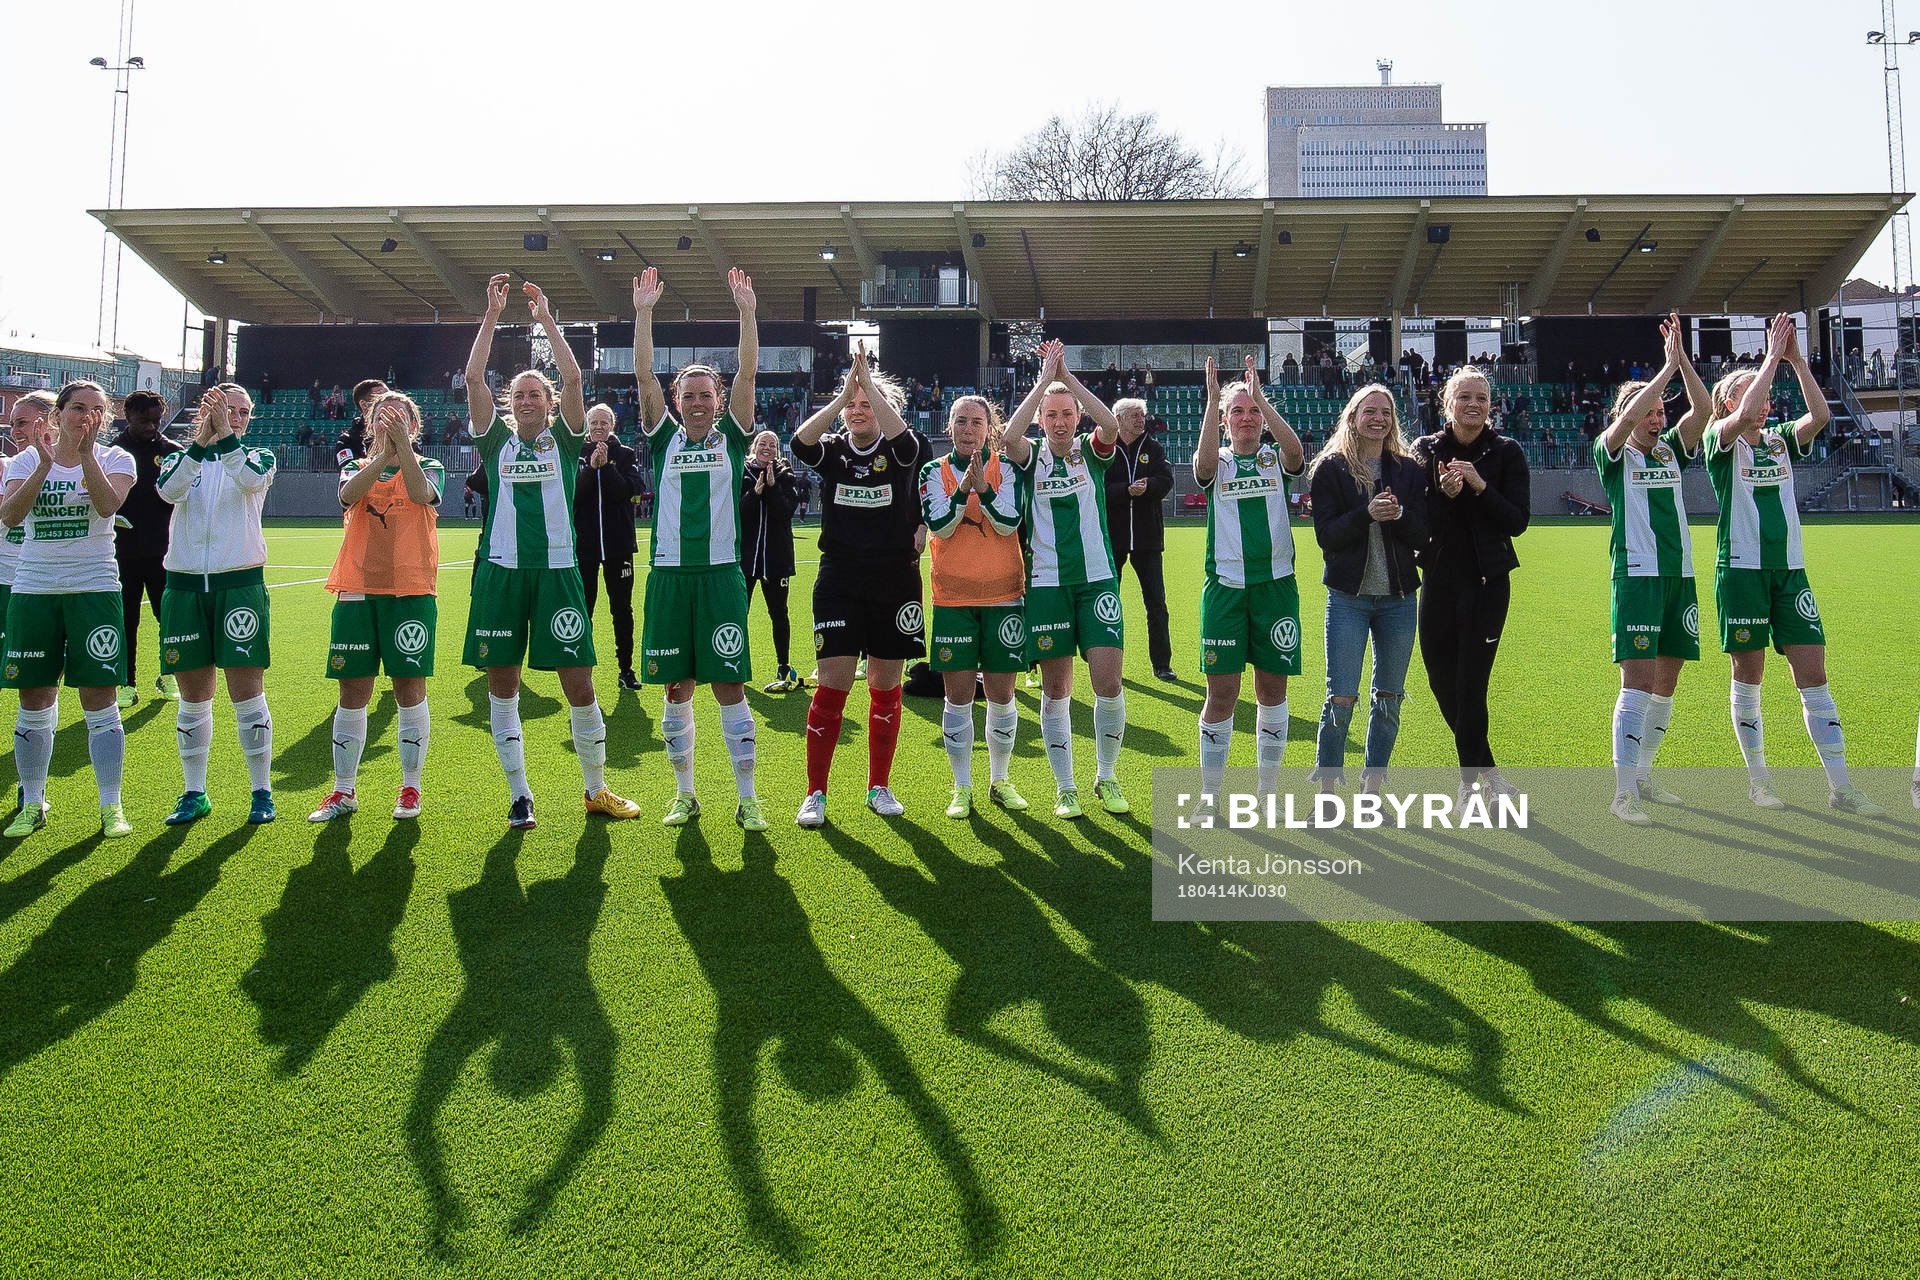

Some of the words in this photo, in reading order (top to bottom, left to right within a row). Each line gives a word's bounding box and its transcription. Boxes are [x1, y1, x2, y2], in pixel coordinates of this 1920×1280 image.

[673, 454, 717, 464] PEAB
[508, 464, 548, 473] PEAB
[41, 480, 76, 491] AJEN
[1042, 477, 1078, 489] PEAB
[1228, 479, 1270, 490] PEAB
[36, 492, 66, 506] MOT
[845, 488, 883, 499] PEAB
[33, 504, 90, 517] CANCER!
[1096, 594, 1120, 622] VW
[227, 610, 257, 638] VW
[900, 604, 923, 632] VW
[1728, 617, 1751, 625] BAJEN
[554, 610, 582, 640] VW
[1001, 616, 1025, 646] VW
[1053, 622, 1070, 630] FANS
[1626, 624, 1650, 632] BAJEN
[181, 633, 200, 642] FANS
[398, 623, 426, 652] VW
[1274, 620, 1297, 648] VW
[89, 628, 119, 657] VW
[715, 626, 742, 655] VW
[660, 648, 680, 656] FANS
